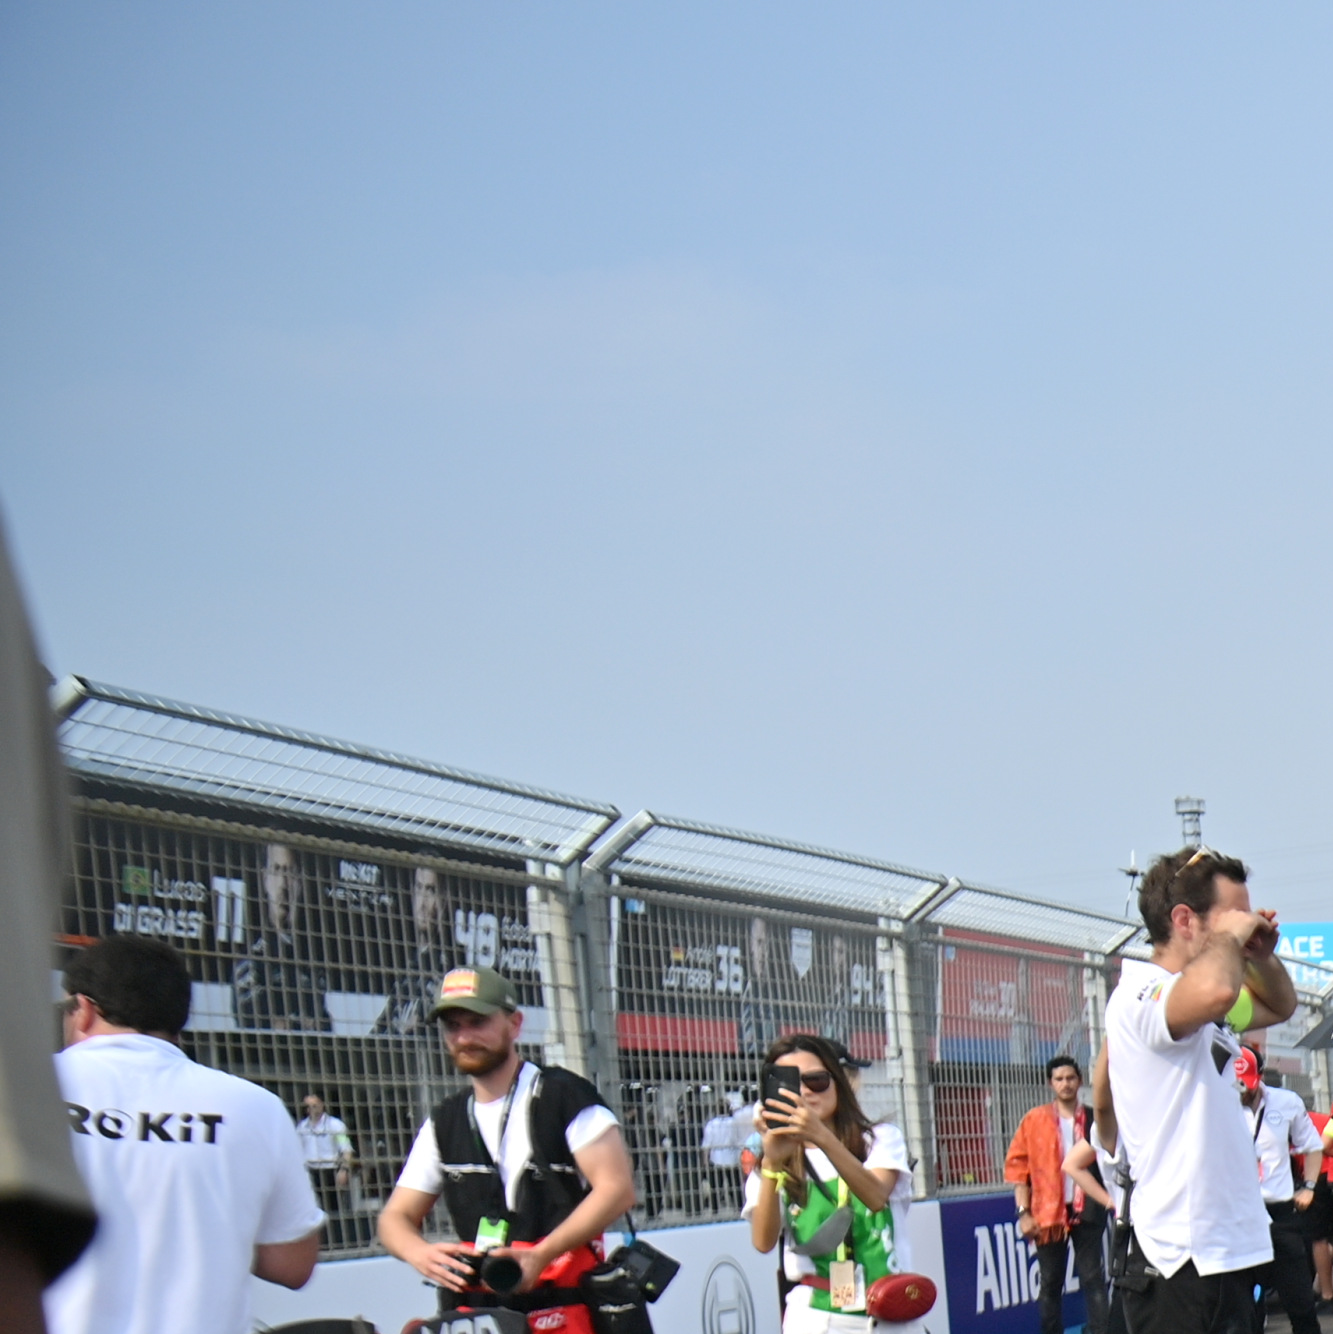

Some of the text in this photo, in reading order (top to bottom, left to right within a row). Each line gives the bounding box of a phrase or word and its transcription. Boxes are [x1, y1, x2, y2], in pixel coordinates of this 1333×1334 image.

[212, 876, 247, 944] 11
[455, 909, 500, 969] 48
[715, 944, 744, 994] 36
[1278, 935, 1324, 959] ACE
[974, 1221, 1080, 1315] Alliaz
